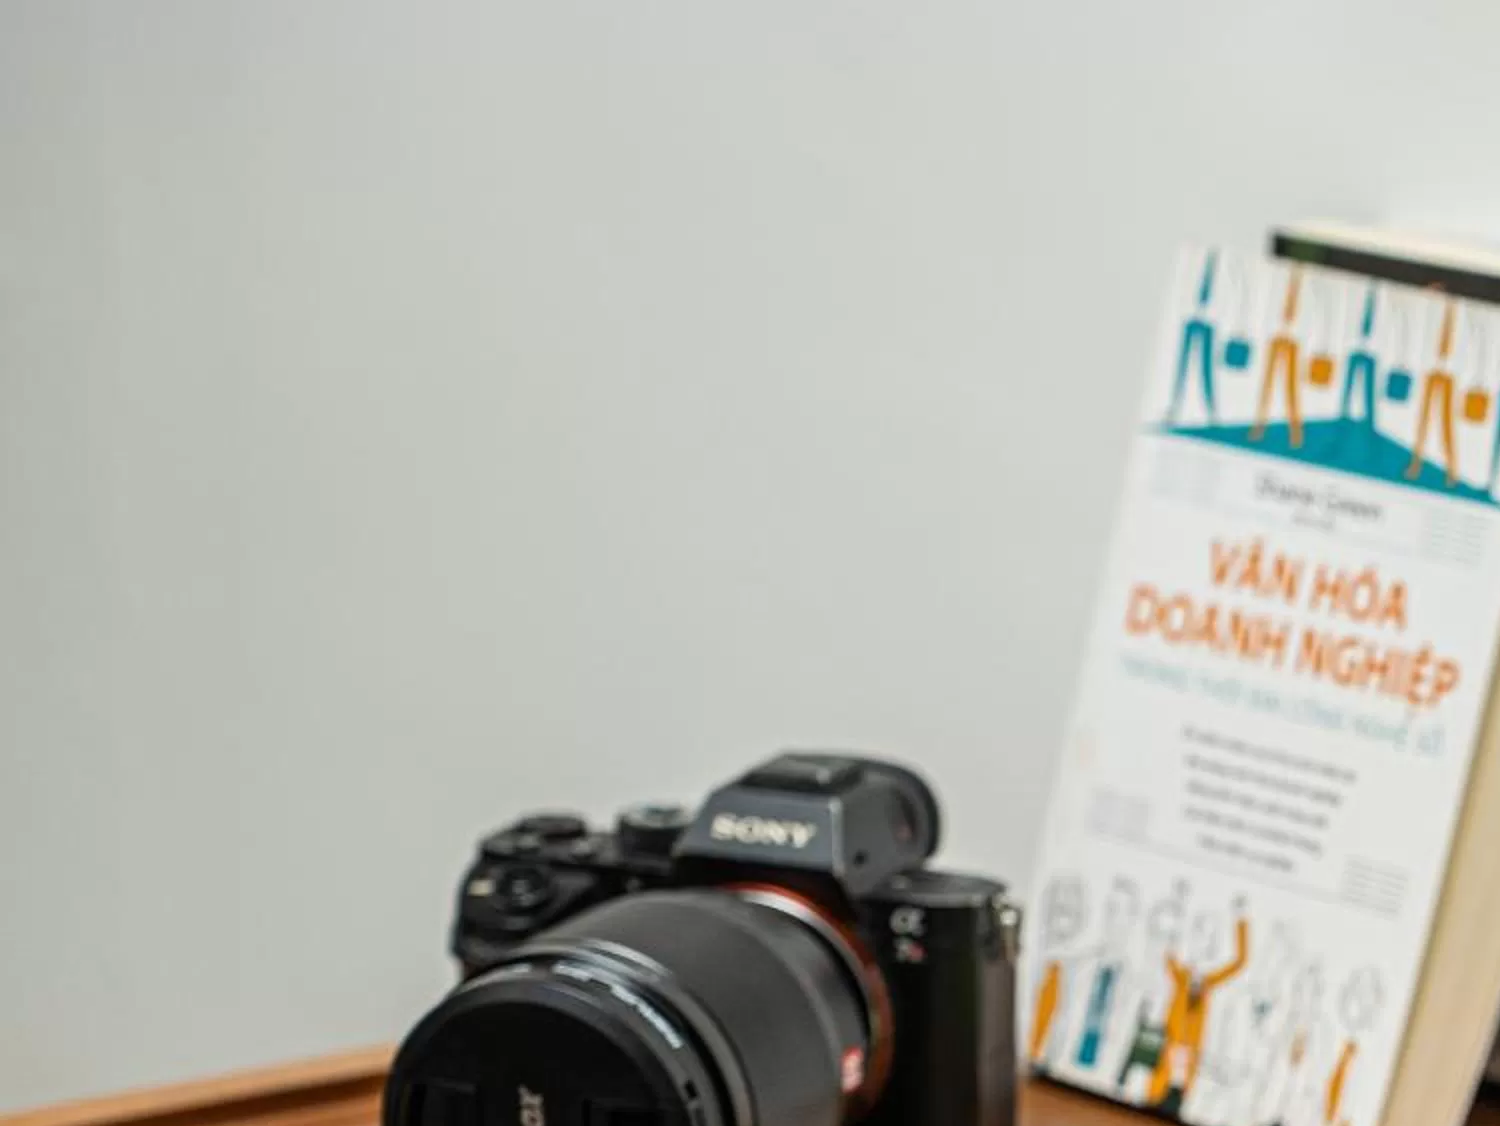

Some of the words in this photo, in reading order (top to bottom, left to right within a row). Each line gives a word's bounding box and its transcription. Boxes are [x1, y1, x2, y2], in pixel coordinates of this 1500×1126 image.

[1308, 561, 1408, 632] HÓA
[1123, 581, 1293, 671] DOANH
[1294, 625, 1462, 709] NGHIỆP
[711, 813, 817, 848] SONY
